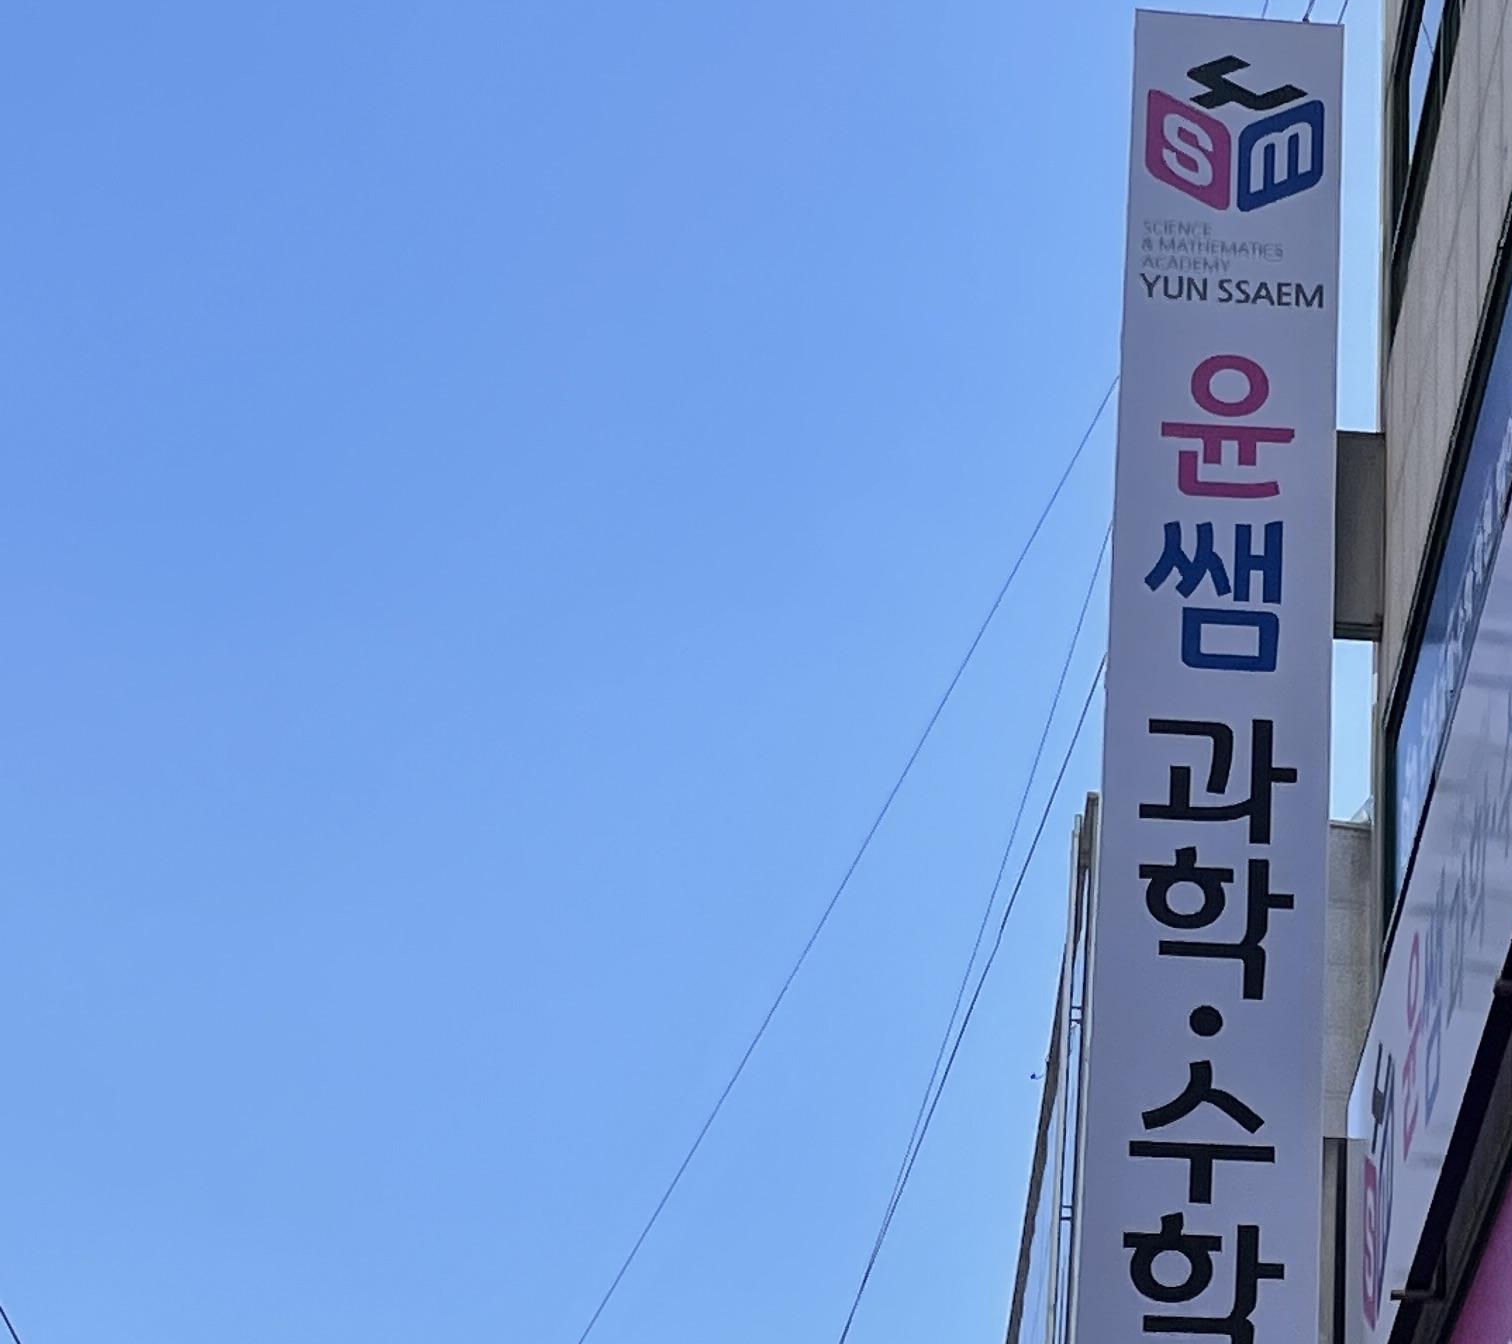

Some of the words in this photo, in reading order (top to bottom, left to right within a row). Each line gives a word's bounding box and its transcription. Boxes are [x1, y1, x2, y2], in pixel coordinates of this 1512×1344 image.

[1140, 273, 1208, 302] YUN
[1217, 278, 1325, 309] SSAEM
[1144, 353, 1296, 673] 윤쌤
